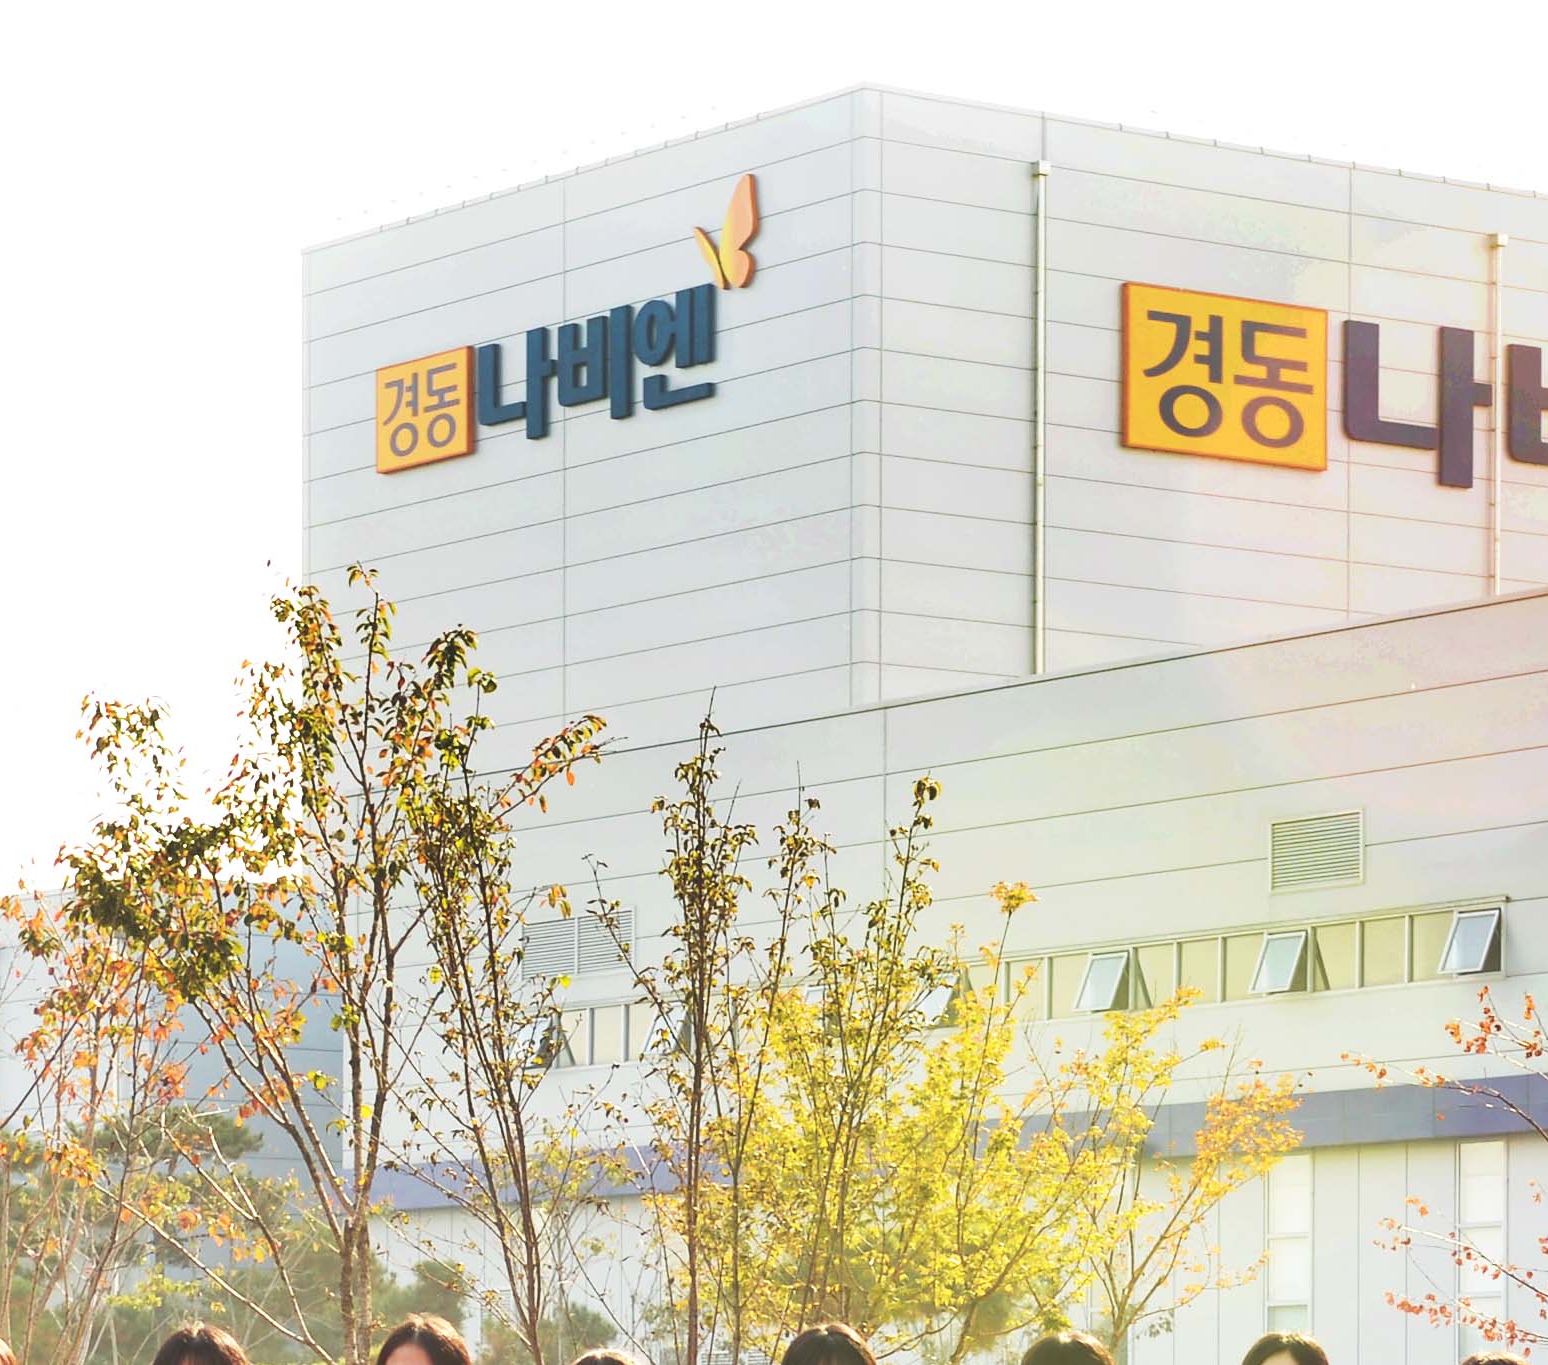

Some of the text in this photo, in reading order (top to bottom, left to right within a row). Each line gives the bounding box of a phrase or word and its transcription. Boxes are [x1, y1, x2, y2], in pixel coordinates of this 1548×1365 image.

[383, 283, 717, 457] 경동 나비엔
[1144, 309, 1313, 449] 경동
